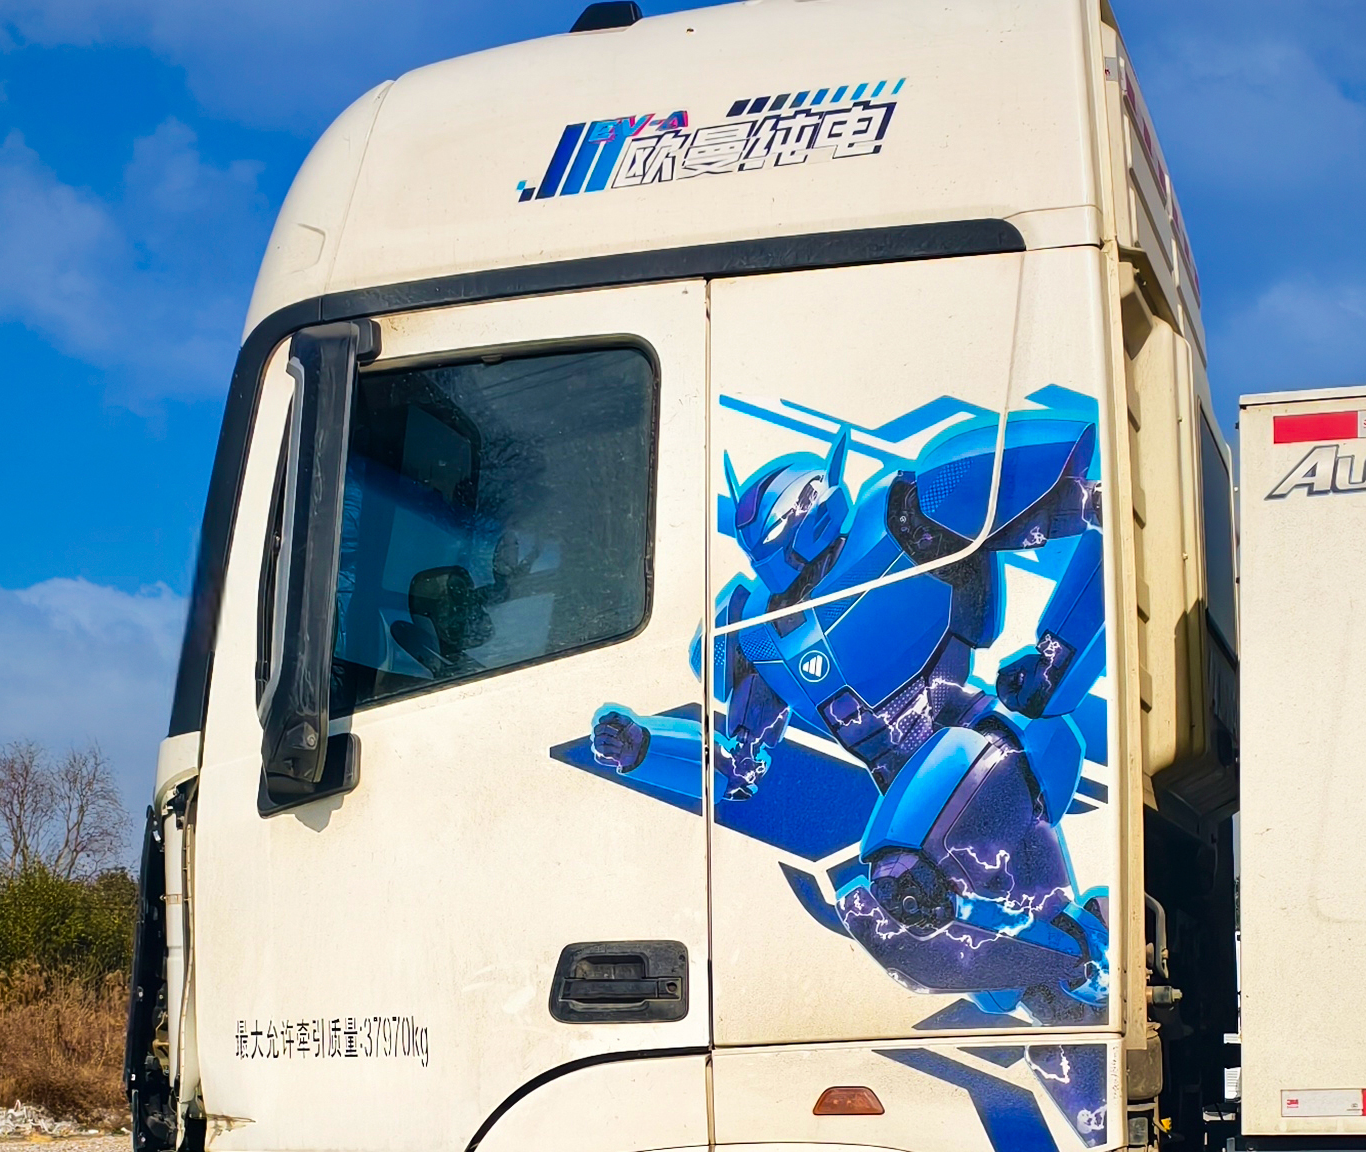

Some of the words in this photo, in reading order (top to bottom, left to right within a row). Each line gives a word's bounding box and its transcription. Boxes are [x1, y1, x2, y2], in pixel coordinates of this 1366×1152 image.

[610, 100, 897, 190] 欧曼纯电
[235, 1016, 429, 1067] 最大允许牵引质量:37970kg
